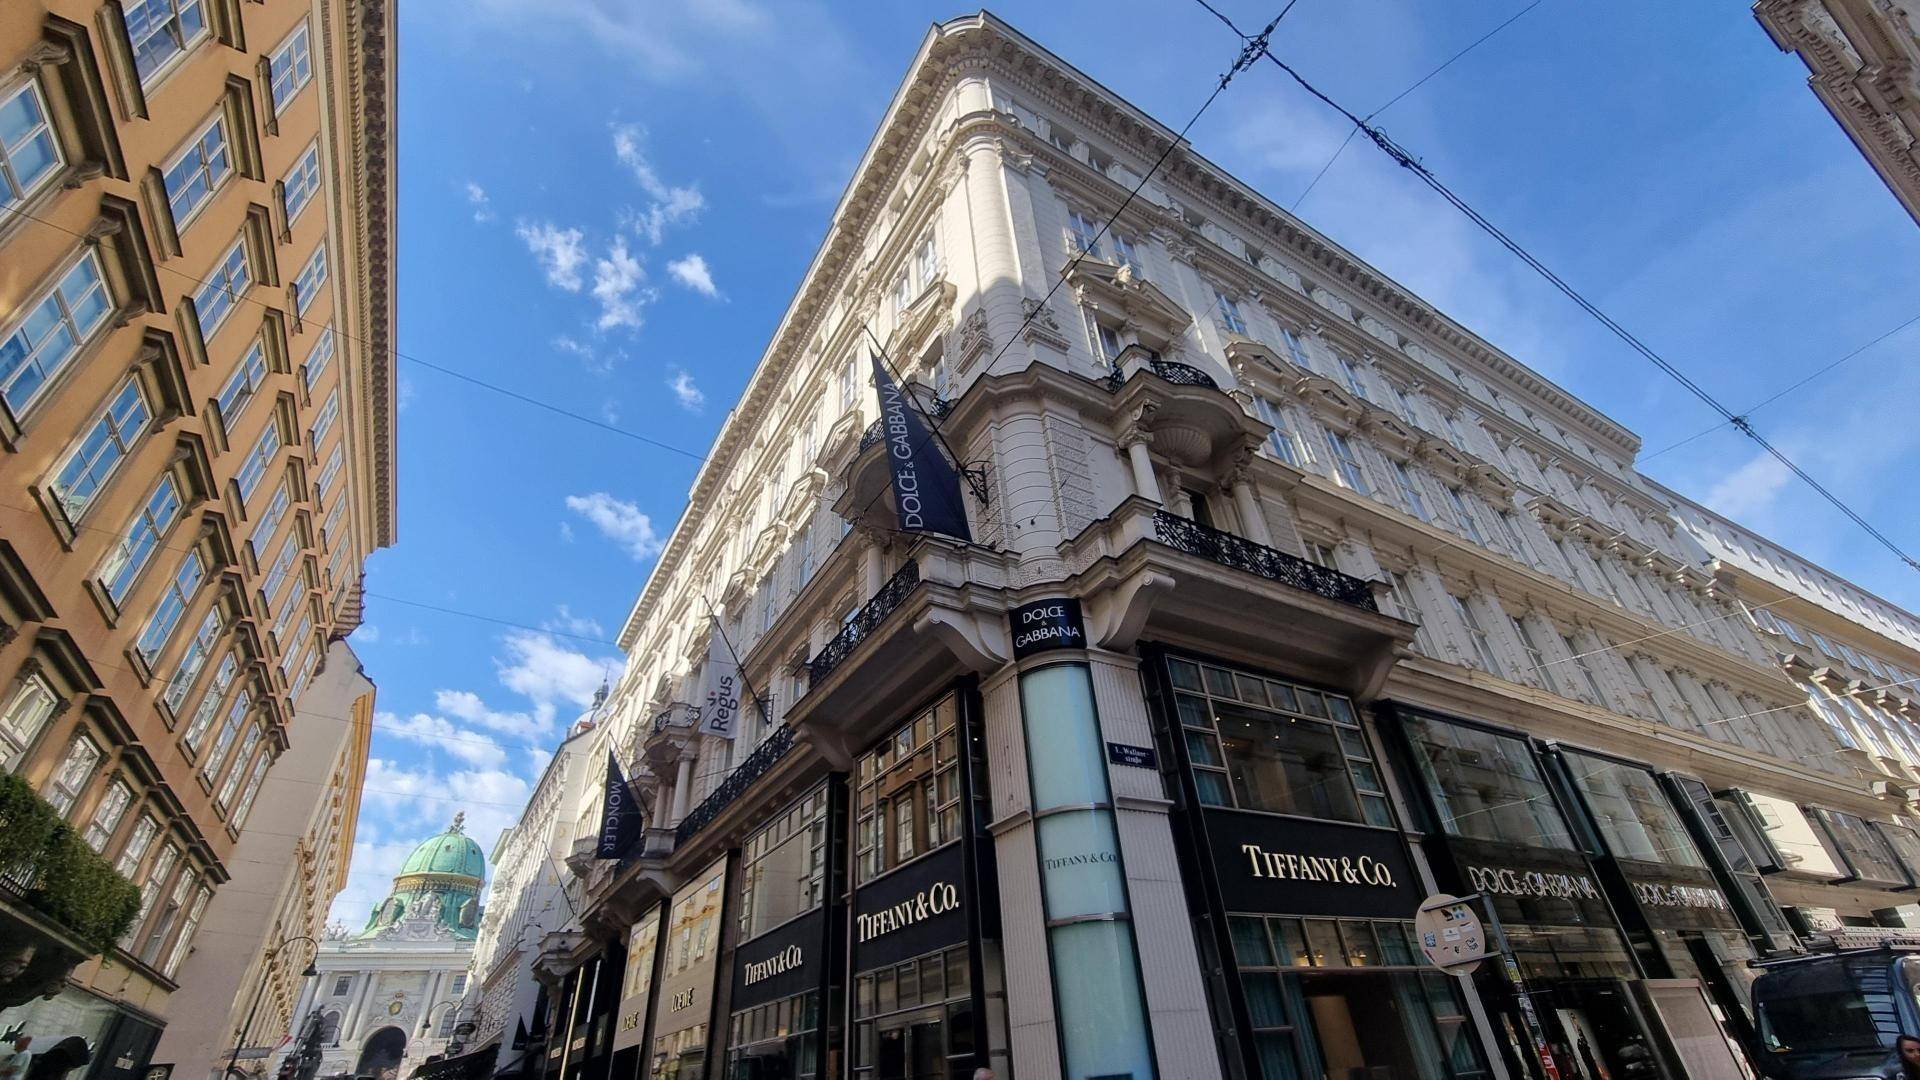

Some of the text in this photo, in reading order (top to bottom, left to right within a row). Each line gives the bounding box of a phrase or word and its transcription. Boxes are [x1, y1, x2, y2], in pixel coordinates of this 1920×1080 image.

[1022, 605, 1065, 624] DOLCE
[1015, 626, 1081, 648] GABBANA
[710, 676, 738, 732] Regus
[603, 781, 622, 852] MONCLER
